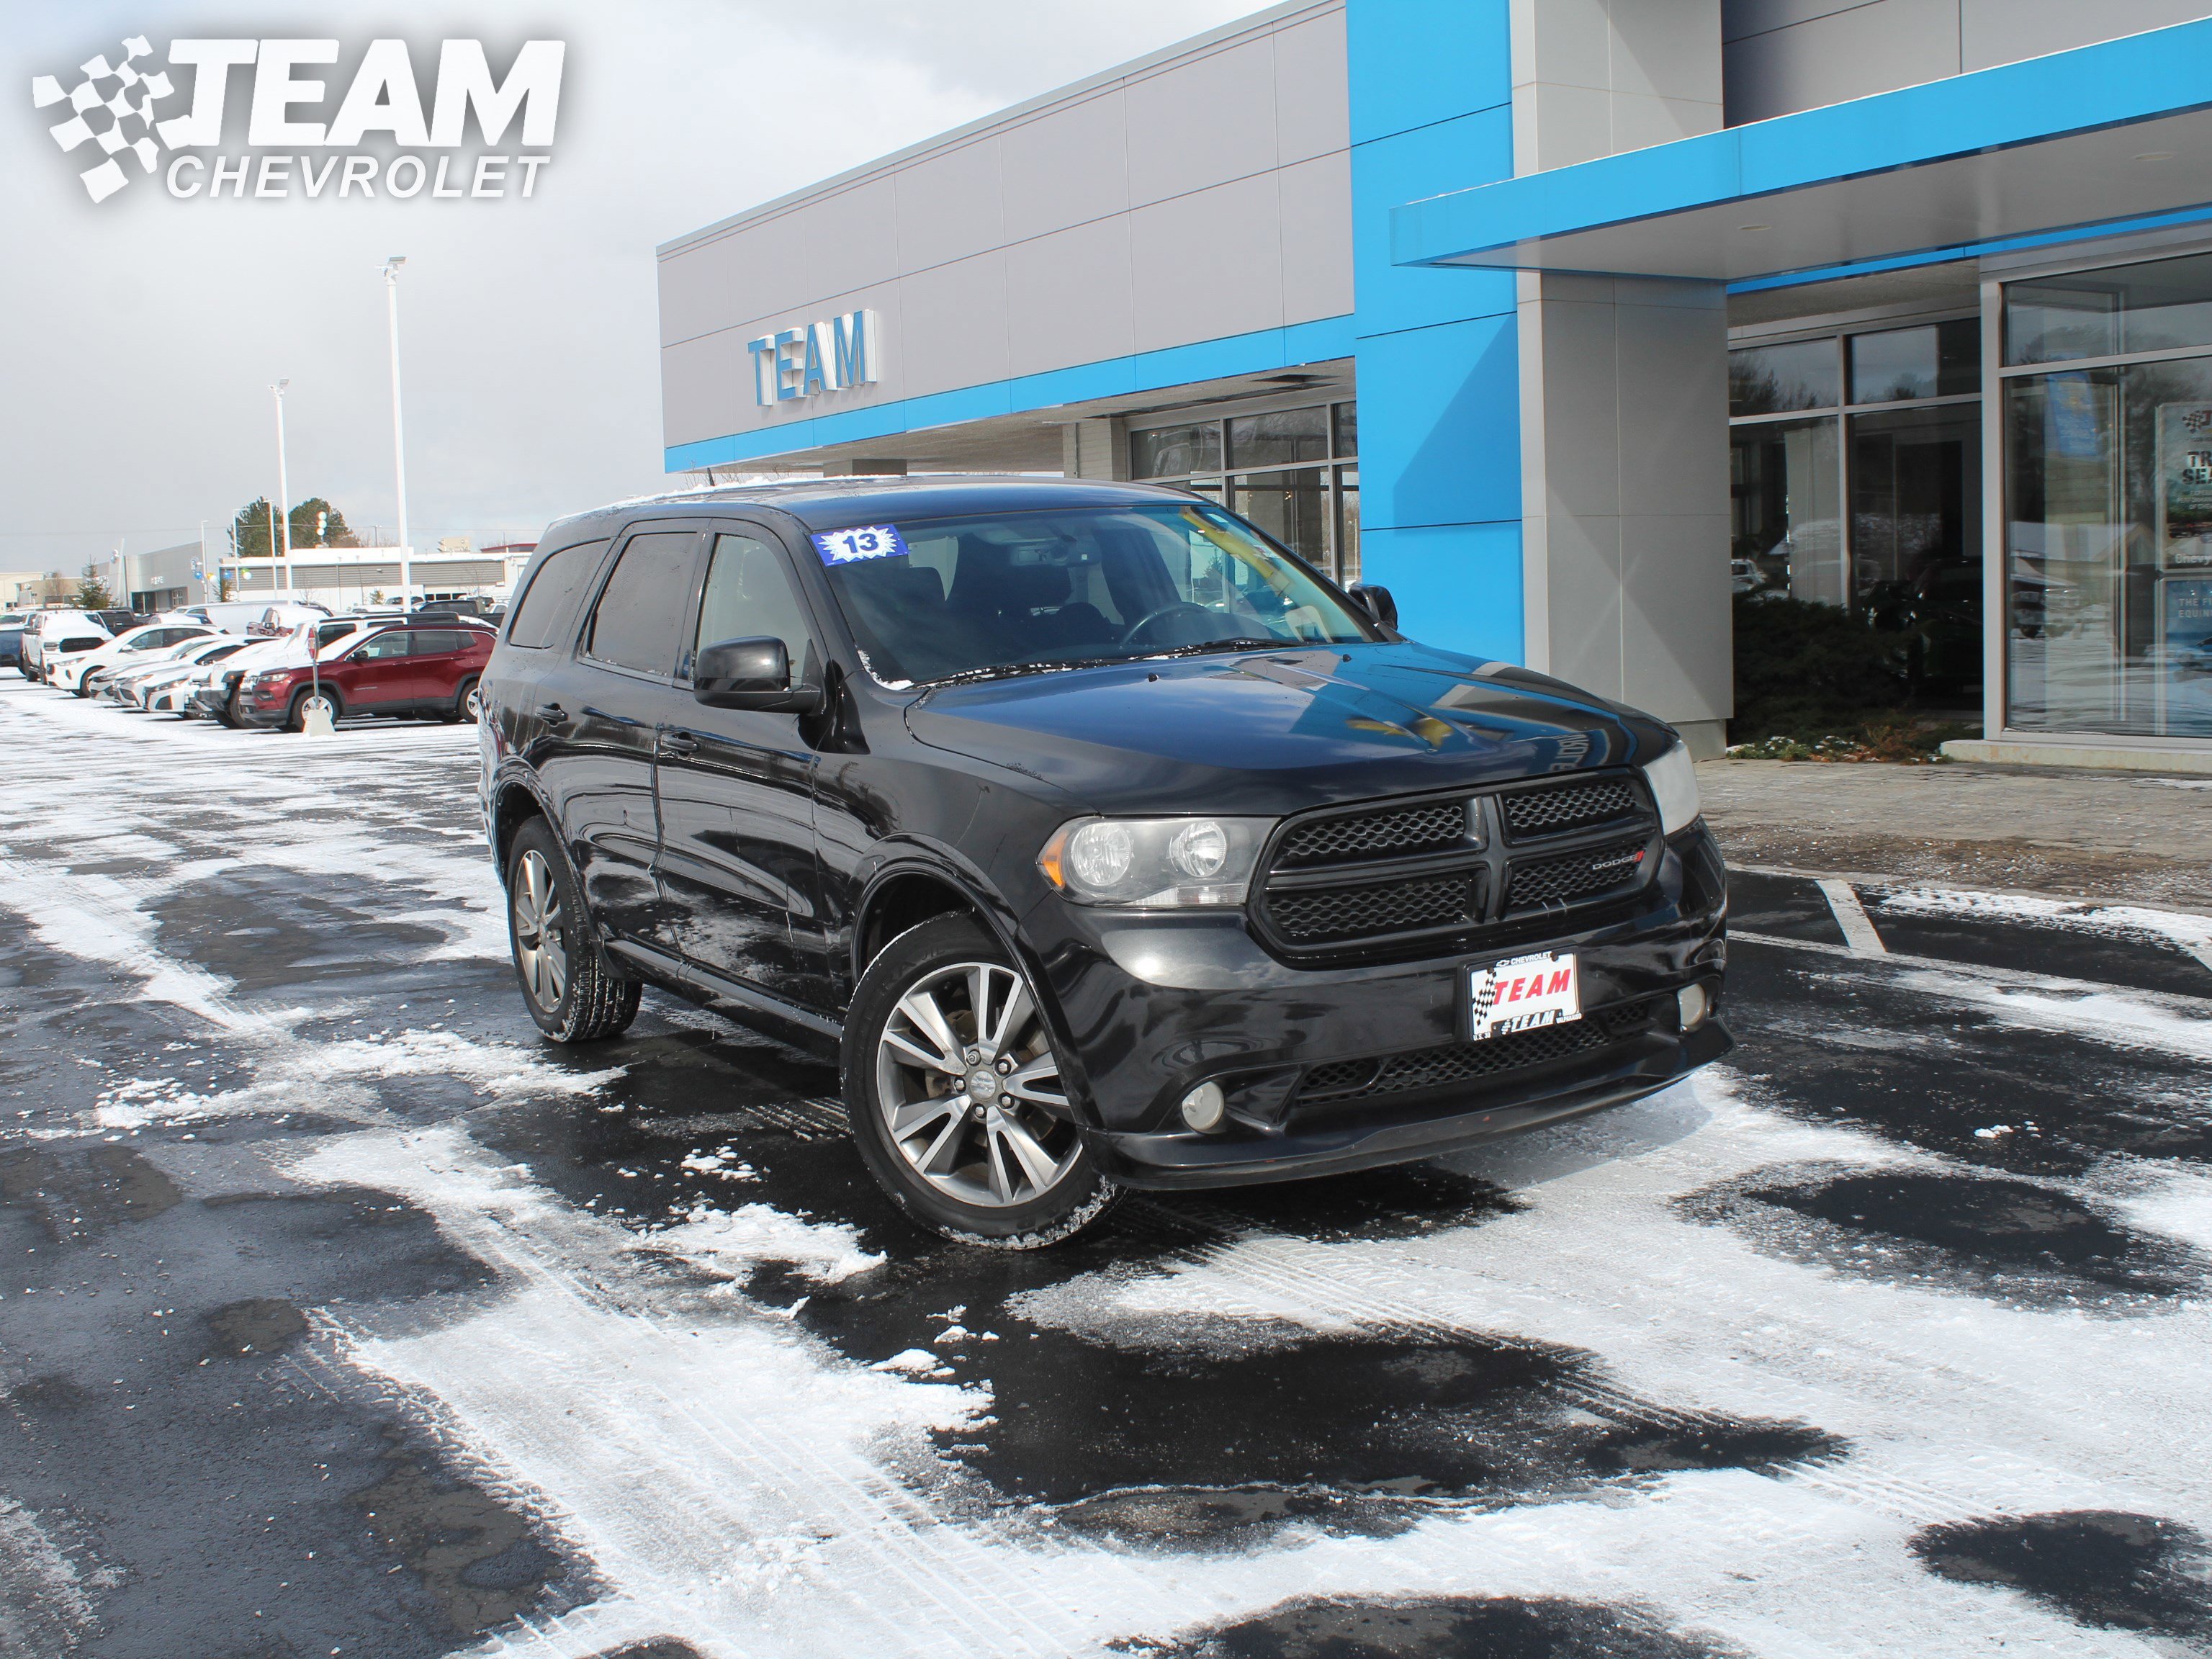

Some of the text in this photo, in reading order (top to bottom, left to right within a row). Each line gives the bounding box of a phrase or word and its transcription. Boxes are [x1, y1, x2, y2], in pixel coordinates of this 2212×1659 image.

[747, 310, 877, 406] TEAM
[842, 534, 879, 554] 13
[1592, 853, 1637, 870] DODGE
[1511, 951, 1552, 966] CHEVROLET
[1493, 968, 1571, 1005] TEAM
[1511, 1010, 1555, 1031] TEAM
